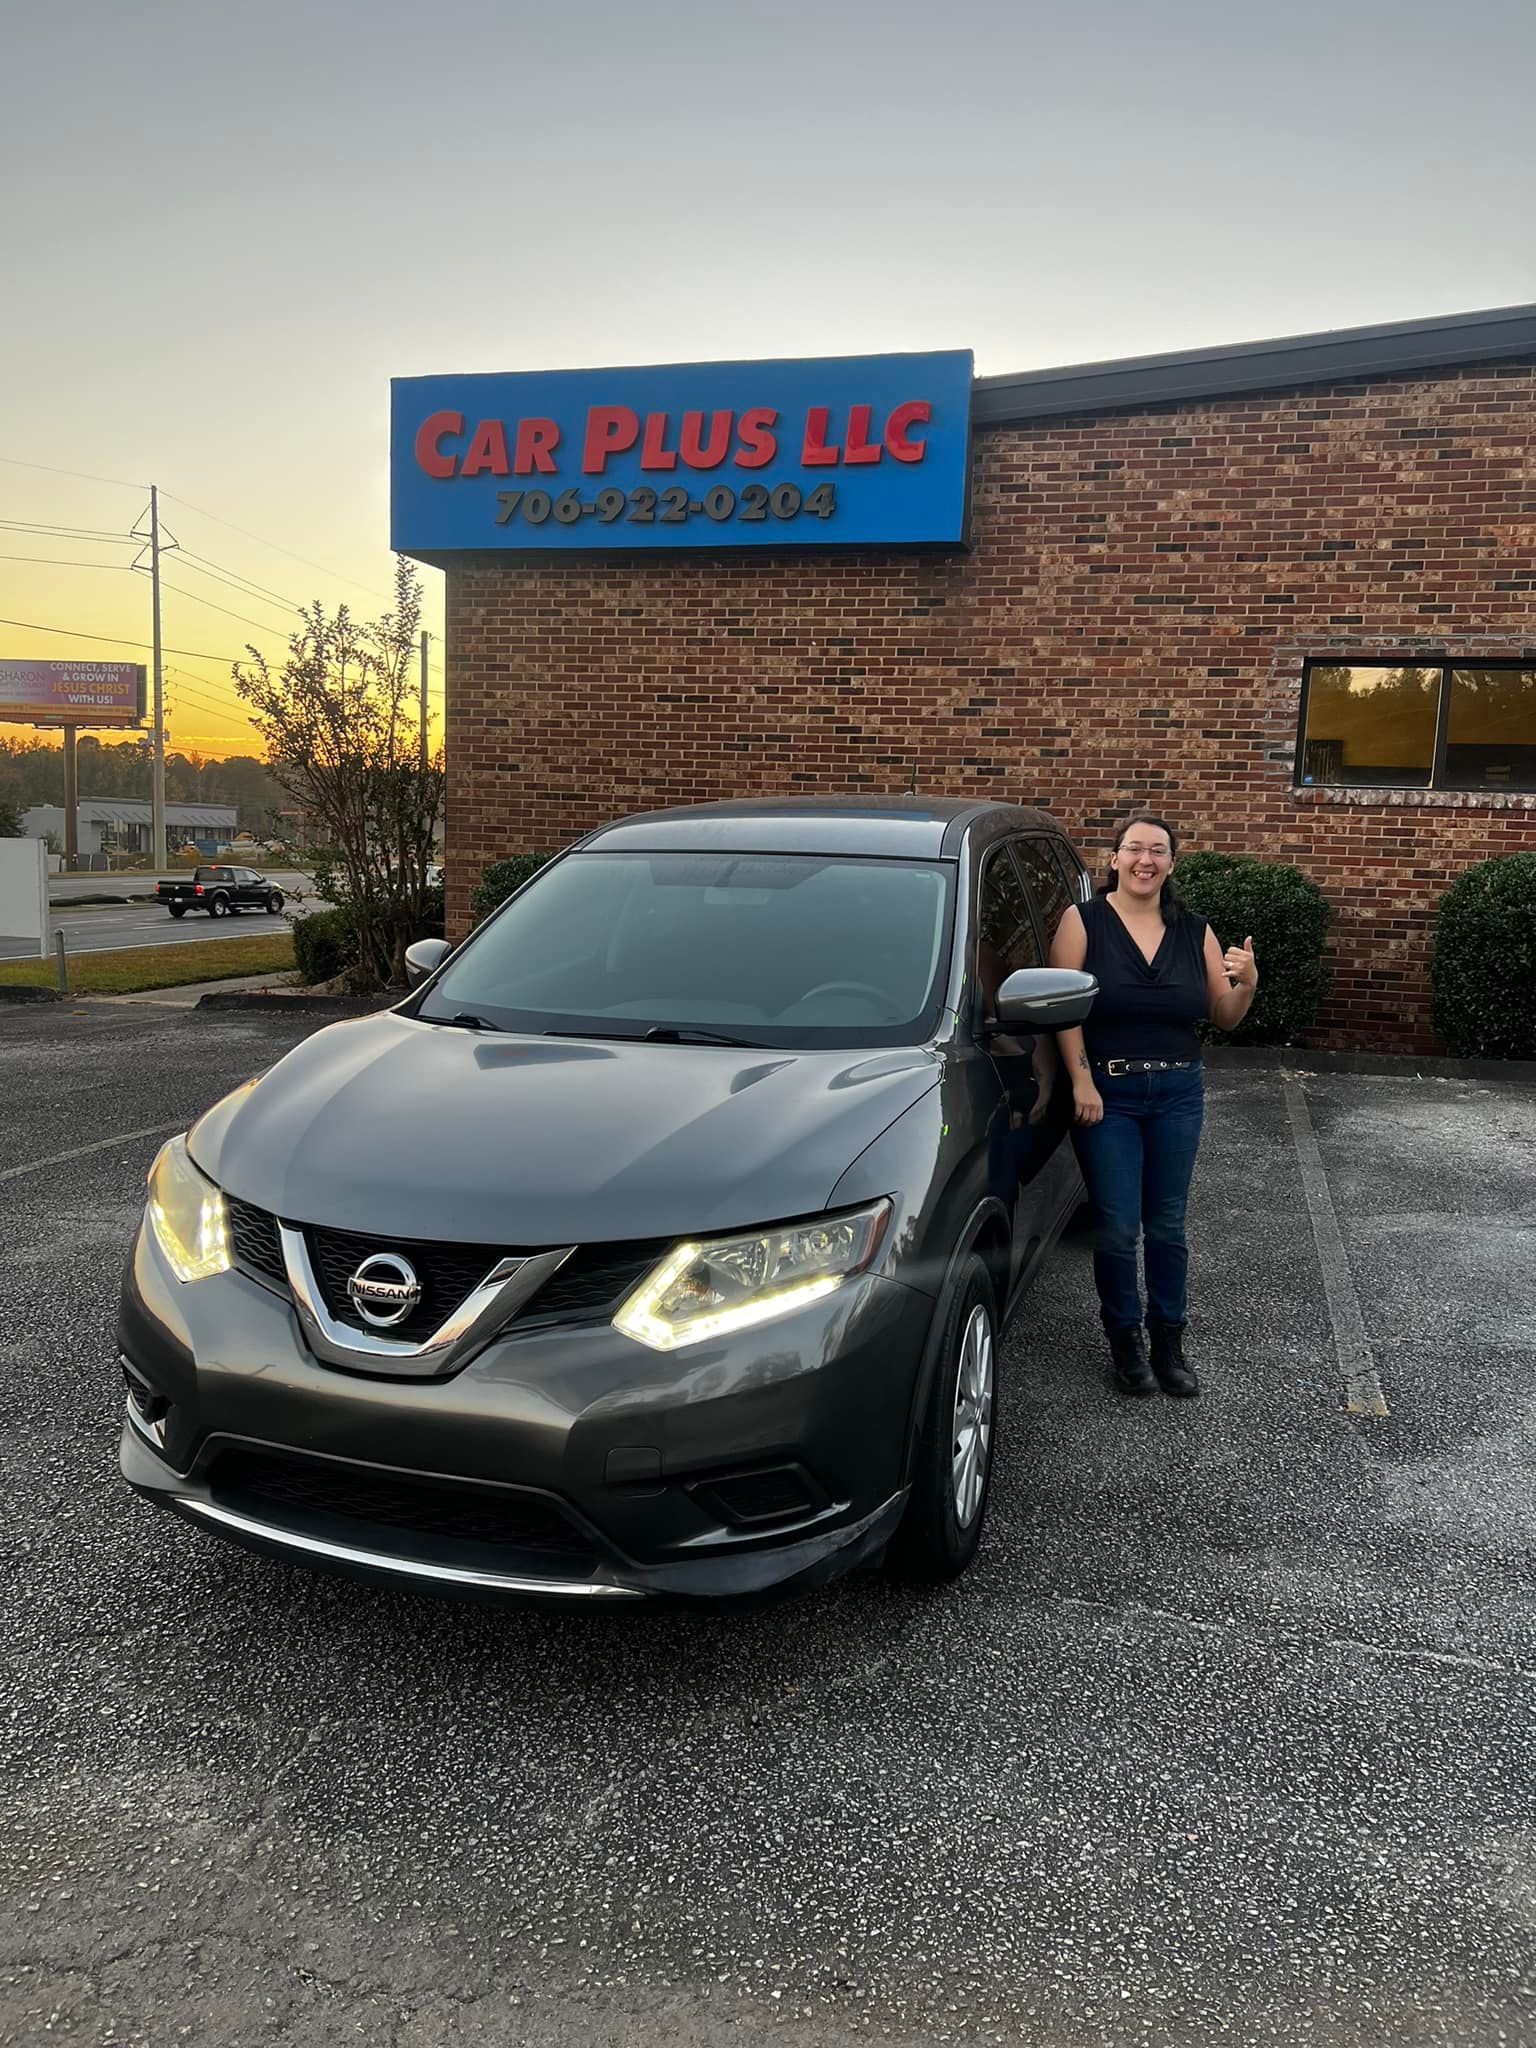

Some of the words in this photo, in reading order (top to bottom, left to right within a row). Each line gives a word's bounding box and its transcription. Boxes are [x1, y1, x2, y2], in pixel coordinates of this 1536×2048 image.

[415, 410, 560, 478] CAR
[583, 404, 779, 474] PLUS
[800, 400, 932, 467] LLC
[495, 482, 837, 525] 706-922-0204
[50, 662, 99, 672] CONNECT,
[103, 664, 131, 673] SERVE
[62, 672, 70, 681] &
[72, 672, 105, 682] GROW
[107, 673, 119, 682] IN
[52, 683, 88, 693] JESUS
[88, 684, 130, 694] CHRIST
[68, 694, 95, 704] WITH
[96, 695, 113, 704] US!
[351, 1281, 410, 1299] NISSAN
